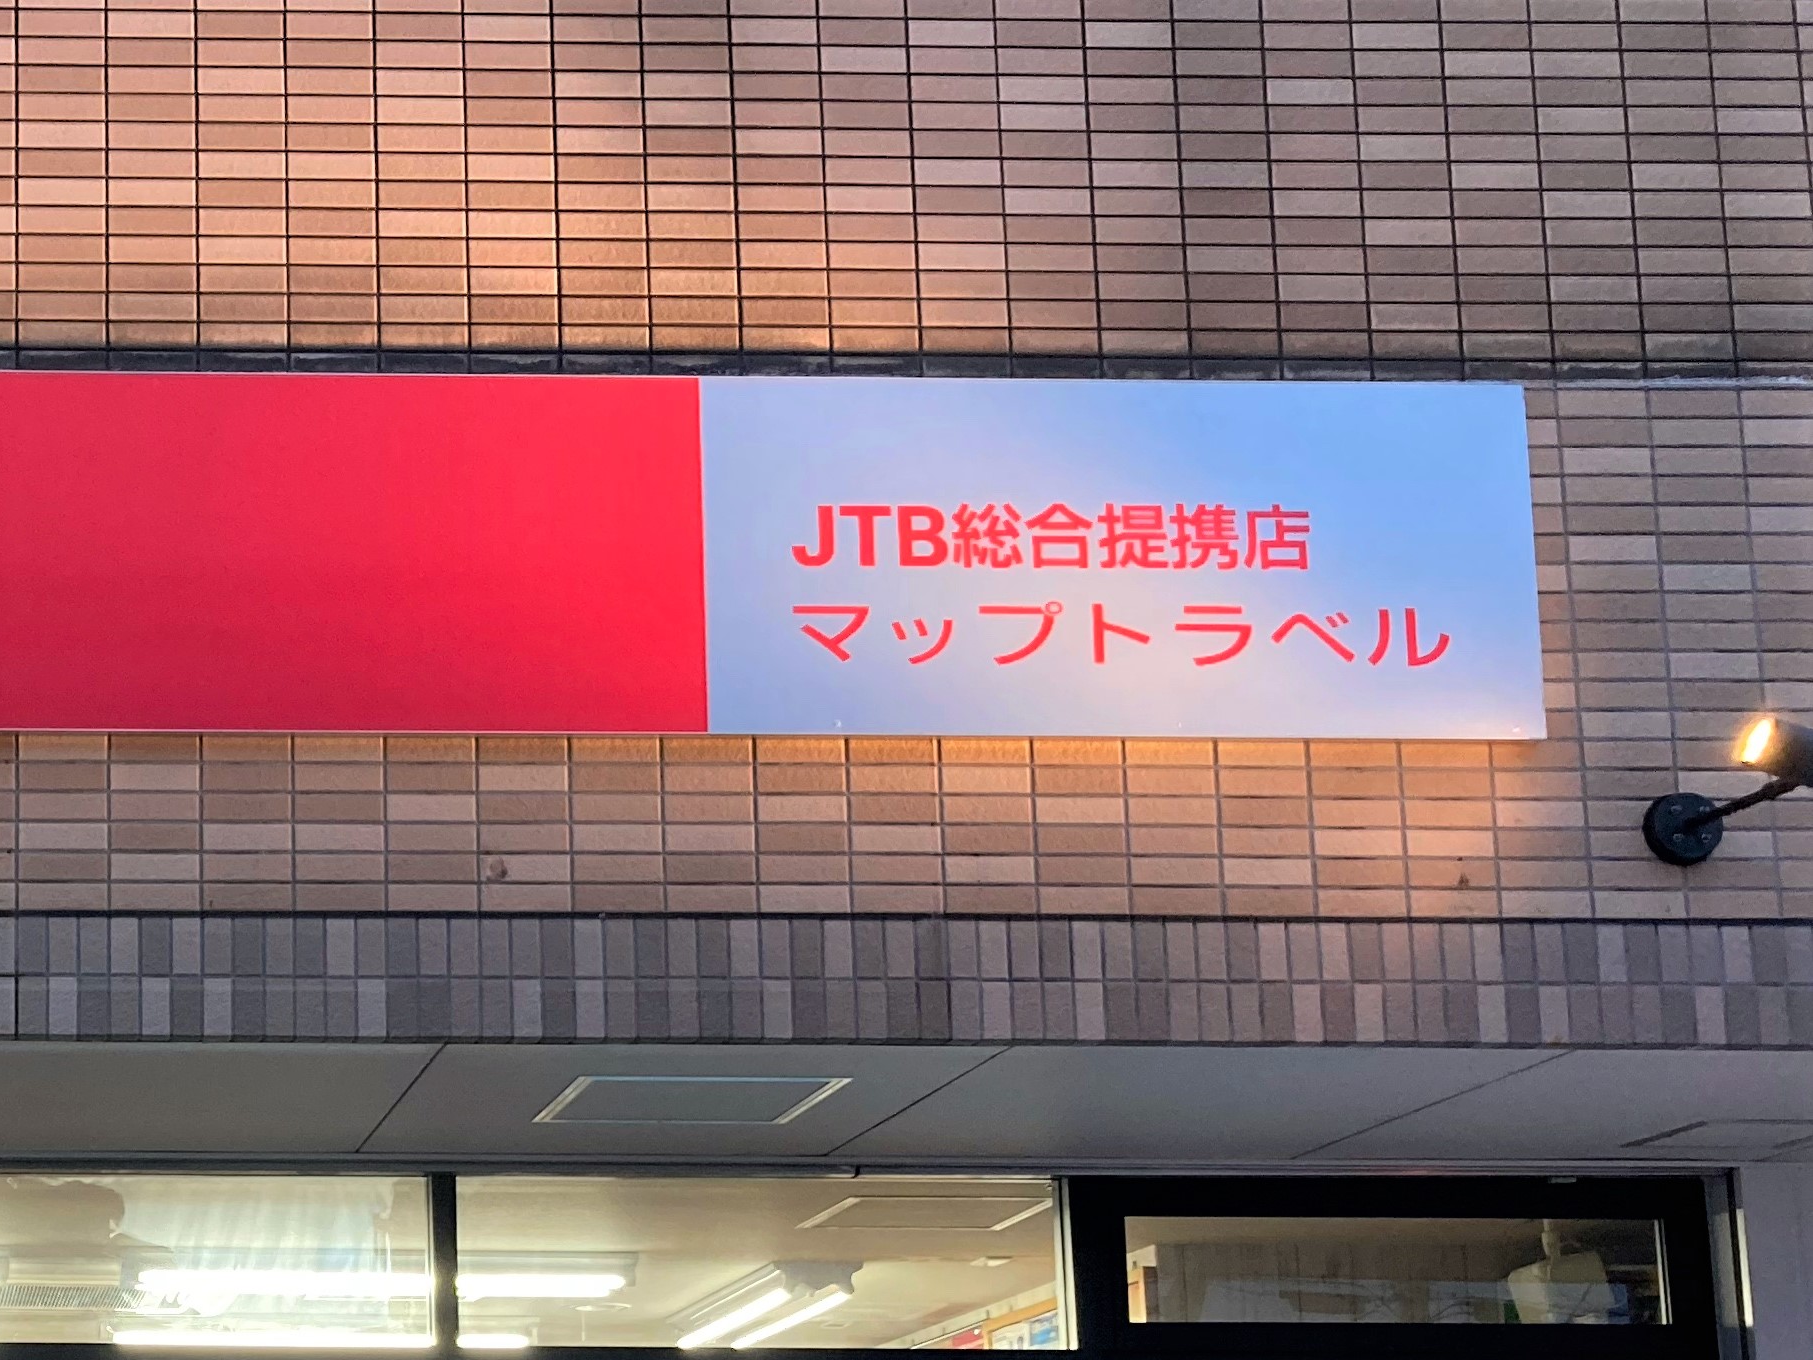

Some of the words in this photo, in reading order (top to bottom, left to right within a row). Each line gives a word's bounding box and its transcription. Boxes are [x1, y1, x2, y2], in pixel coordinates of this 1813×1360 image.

[791, 503, 1311, 571] JTB総合提携店
[791, 603, 1451, 667] マップトラベル
